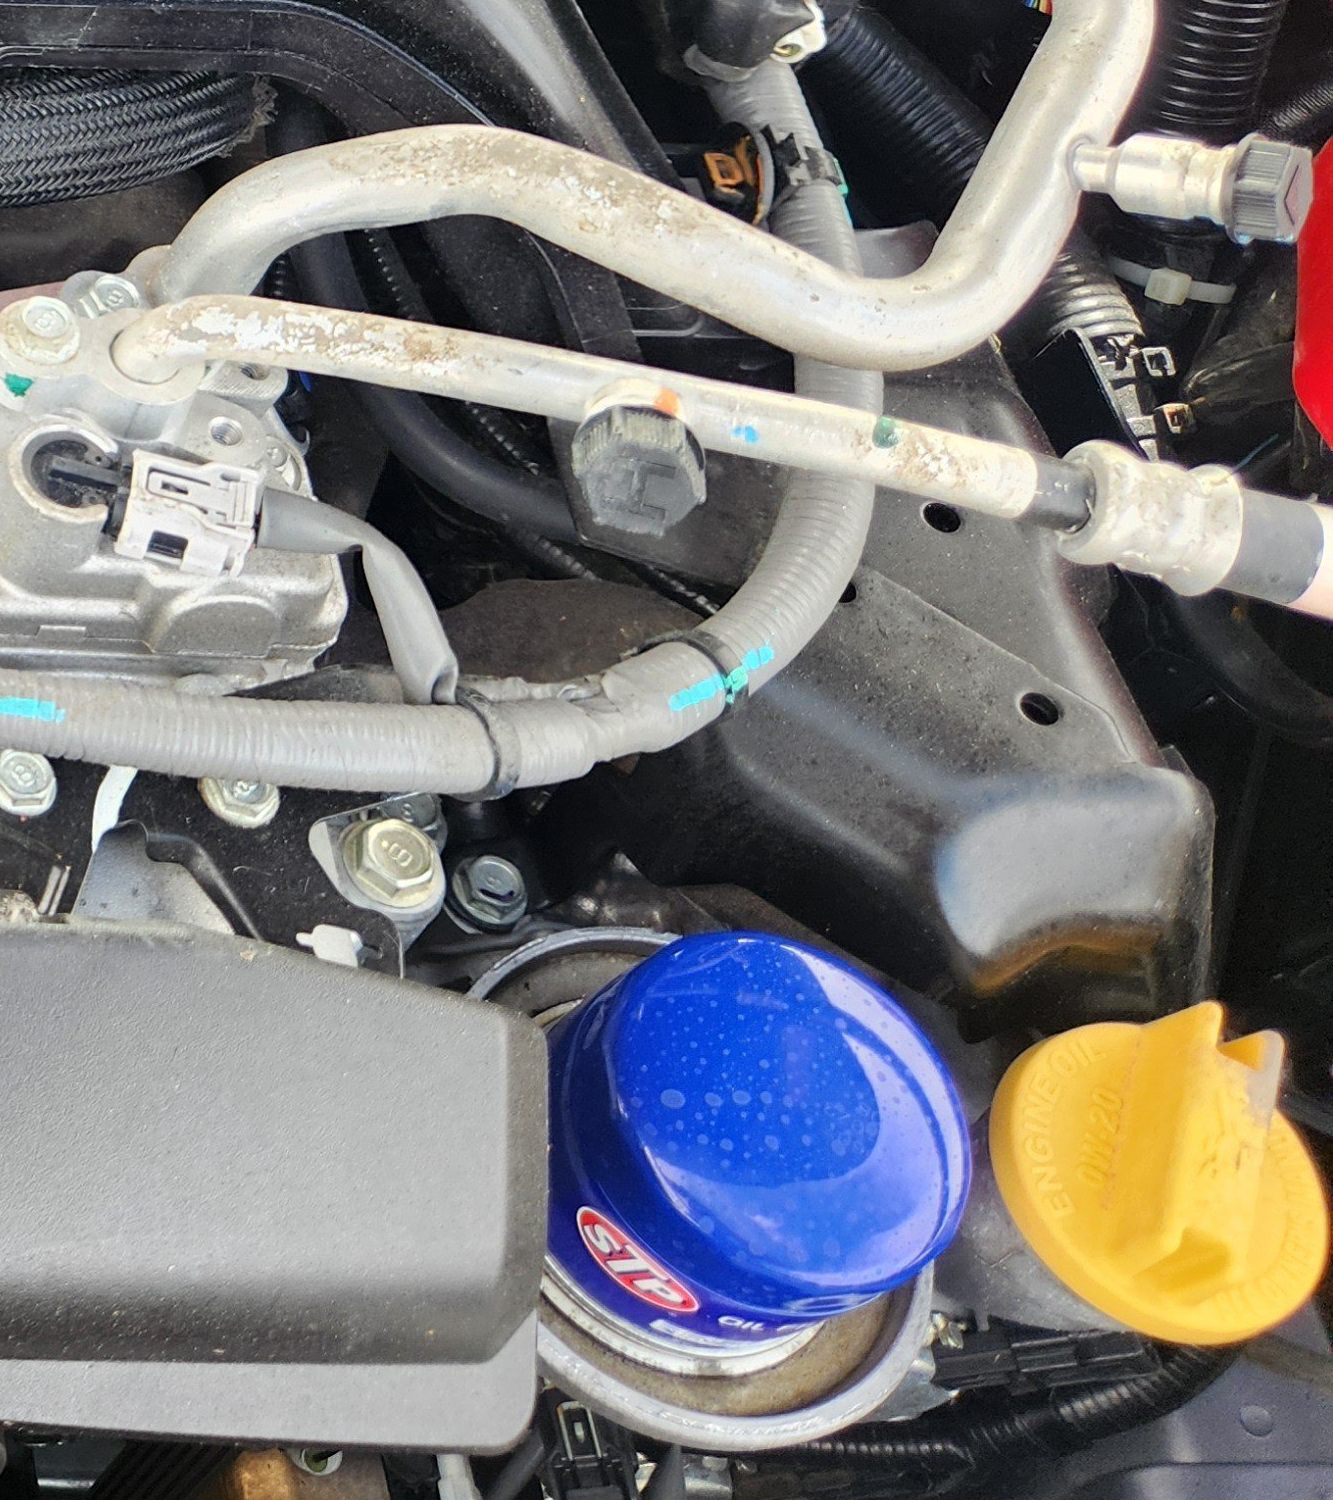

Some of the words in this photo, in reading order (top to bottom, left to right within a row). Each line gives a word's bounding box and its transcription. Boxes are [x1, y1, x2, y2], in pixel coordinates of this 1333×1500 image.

[1048, 1040, 1107, 1078] OIL
[1023, 1074, 1078, 1221] ENGINE
[1077, 1086, 1124, 1186] 0W-20
[583, 1223, 688, 1306] STP
[718, 1315, 766, 1333] OIL
